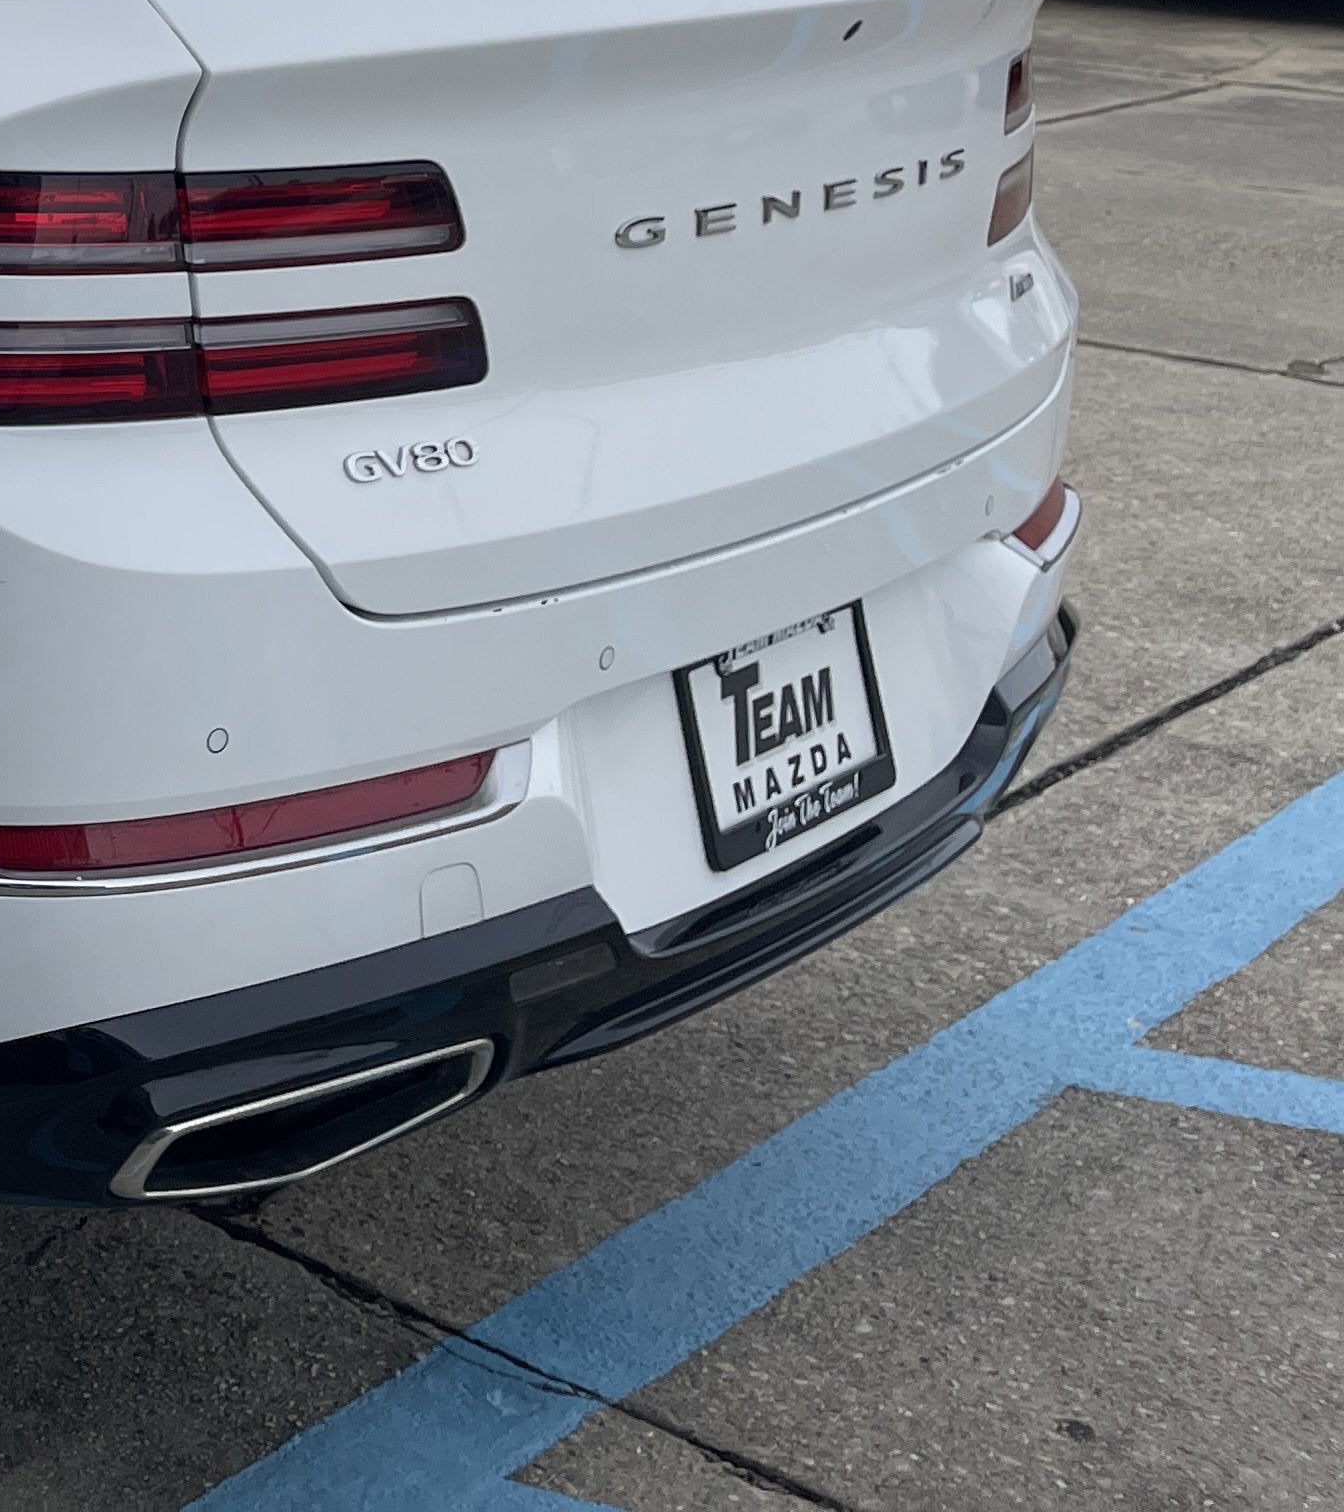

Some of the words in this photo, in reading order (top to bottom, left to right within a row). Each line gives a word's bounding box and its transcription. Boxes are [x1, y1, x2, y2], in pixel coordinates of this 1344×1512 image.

[614, 148, 967, 249] GENESIS
[343, 437, 480, 483] GV80
[721, 660, 835, 766] TEAM
[732, 732, 852, 814] MAZDA
